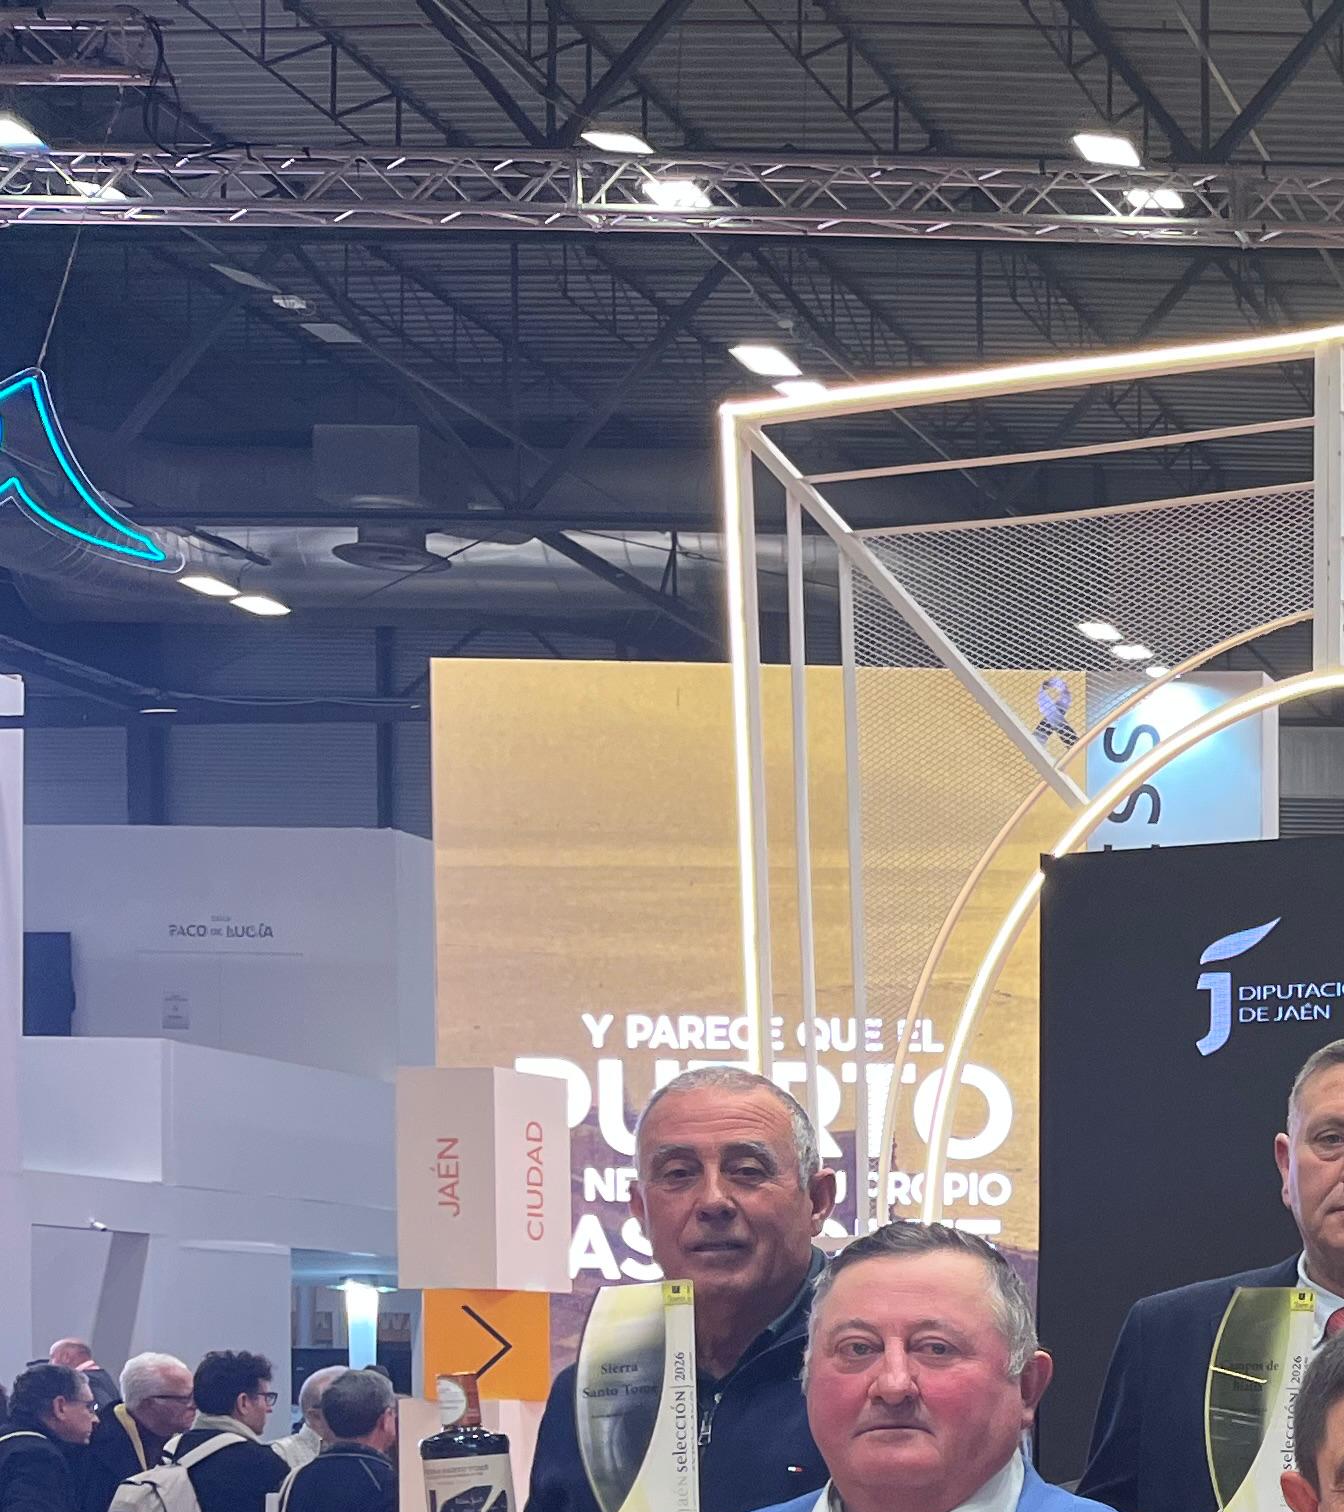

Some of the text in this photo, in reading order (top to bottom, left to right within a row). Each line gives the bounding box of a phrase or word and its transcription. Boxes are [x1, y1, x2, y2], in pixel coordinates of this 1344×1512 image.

[169, 924, 207, 938] PACO
[226, 922, 274, 938] LUCÍA
[1239, 1003, 1330, 1023] DE JAÉN
[582, 1012, 614, 1049] Y
[626, 1015, 784, 1051] PARECE
[797, 1016, 883, 1053] QUE
[514, 1056, 1013, 1160] PURTO
[430, 1137, 460, 1217] JAÉN
[526, 1121, 544, 1241] CIUDAD
[601, 1363, 638, 1375] Sierra
[674, 1352, 685, 1381] 2026
[1266, 1360, 1279, 1371] de
[1292, 1356, 1303, 1383] 2026
[582, 1387, 618, 1398] Santo
